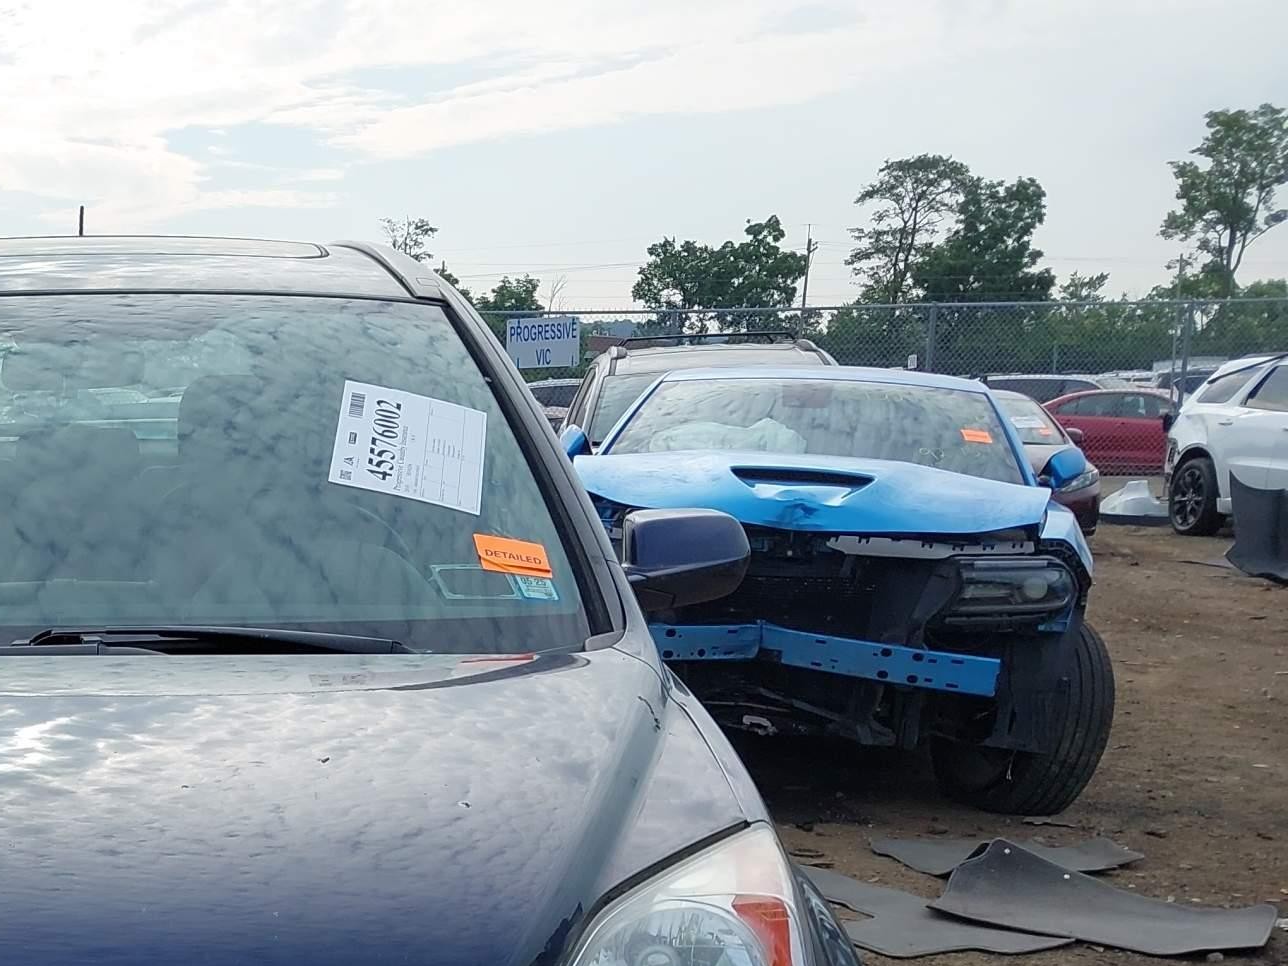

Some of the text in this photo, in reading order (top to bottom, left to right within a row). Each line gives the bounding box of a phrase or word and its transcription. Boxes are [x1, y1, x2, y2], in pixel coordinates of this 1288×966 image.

[510, 322, 577, 342] PROGRESSIVE
[536, 349, 551, 365] VIC
[366, 400, 402, 480] 45576002
[485, 549, 542, 565] DETAILED
